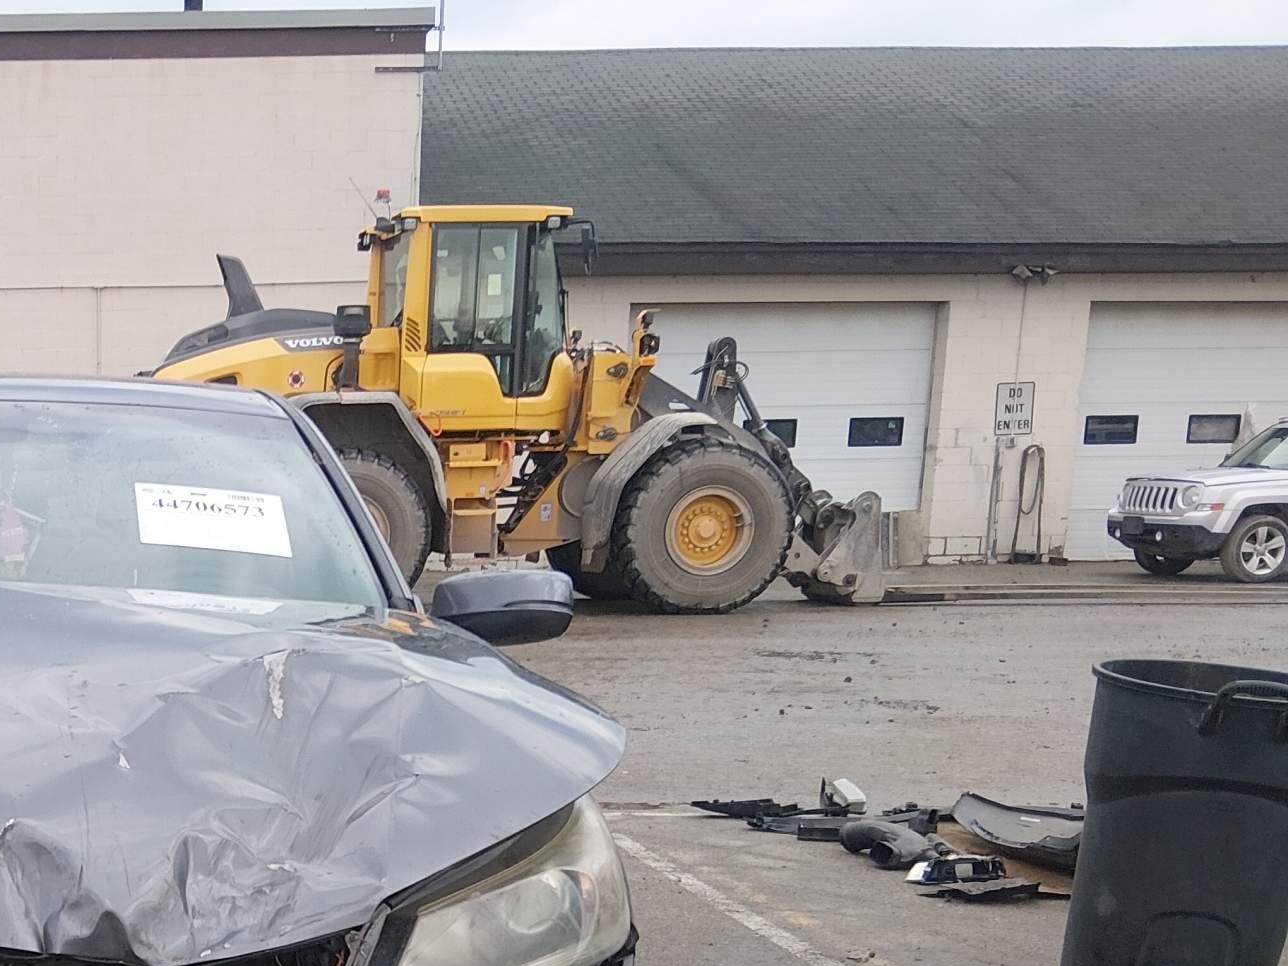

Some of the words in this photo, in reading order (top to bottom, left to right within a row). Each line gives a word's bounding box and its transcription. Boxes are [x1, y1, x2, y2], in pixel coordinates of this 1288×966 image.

[285, 335, 344, 348] VOLVO
[1008, 387, 1023, 399] DO
[1004, 403, 1025, 414] NOT
[152, 498, 265, 517] 44706573
